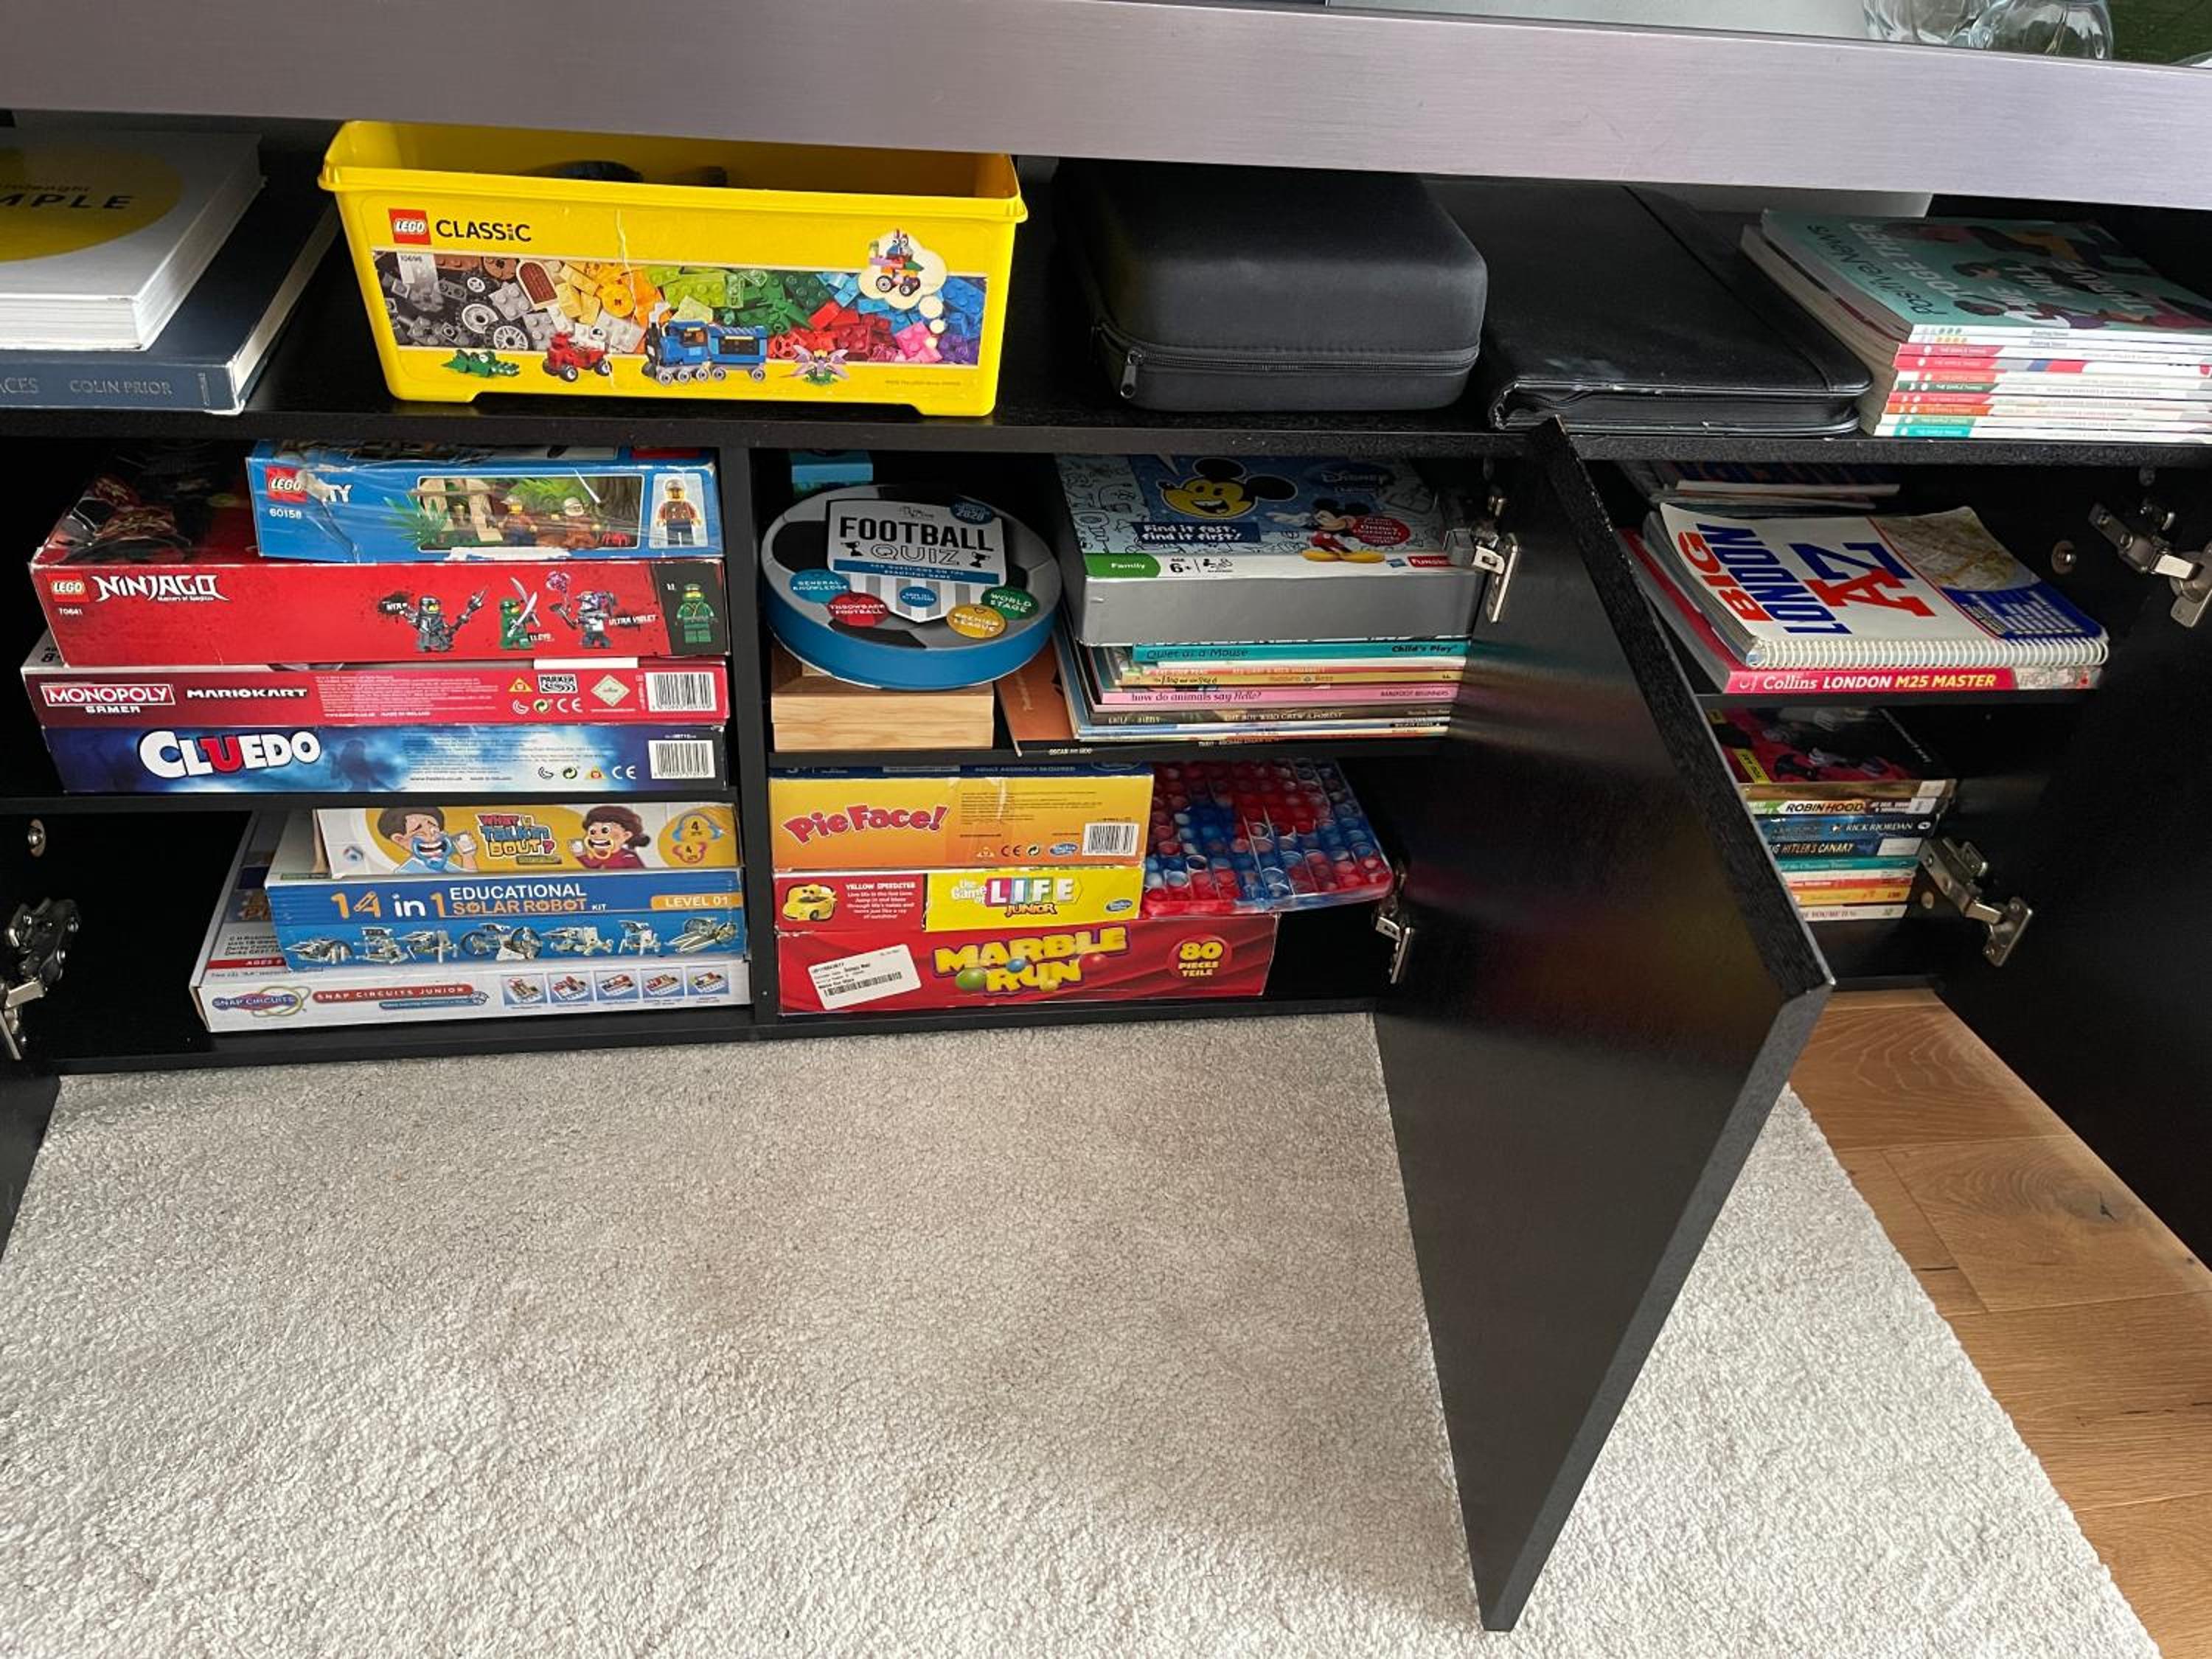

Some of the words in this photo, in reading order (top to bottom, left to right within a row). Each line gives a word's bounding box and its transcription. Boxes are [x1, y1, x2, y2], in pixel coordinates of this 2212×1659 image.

[395, 219, 425, 234] LEGO
[70, 380, 119, 394] COLIN
[123, 380, 173, 395] PRIOR
[840, 517, 994, 552] FOOTBALL
[1144, 524, 1176, 532] Find
[1180, 524, 1193, 532] it
[1142, 532, 1176, 540] find
[1180, 532, 1193, 540] it
[1197, 533, 1242, 541] first!
[871, 543, 959, 566] QUIZ
[1677, 531, 1774, 622] BIG
[1695, 523, 1853, 635] LONDON
[53, 581, 85, 594] LEGO
[91, 575, 231, 602] NINJAGO
[990, 593, 1032, 608] WORLD
[608, 617, 632, 626] ULTRA
[1147, 649, 1180, 660] Quiet
[1209, 648, 1248, 657] Mouse
[1391, 644, 1427, 653] Child's
[1430, 645, 1455, 654] Play
[540, 675, 575, 684] PARKER
[1763, 675, 1818, 690] Collins
[1822, 676, 1891, 689] LONDON
[1895, 675, 1929, 687] M25
[1932, 675, 1997, 687] MASTER
[48, 686, 167, 703] MONOPOLY
[1132, 693, 1154, 702] how
[1155, 693, 1169, 701] do
[1175, 692, 1211, 701] animals
[1214, 694, 1232, 704] say
[86, 706, 141, 714] GAMER
[139, 730, 321, 779] CLUEDO
[1786, 802, 1825, 813] ROBIN
[1826, 801, 1863, 812] HOOD
[691, 821, 698, 831] 4
[783, 812, 849, 844] Pie
[847, 804, 949, 831] Face!
[1846, 823, 1869, 832] RICK
[1870, 822, 1913, 831] RIORDAN
[1781, 843, 1816, 855] HITLER'S
[1818, 843, 1853, 854] CANARY
[450, 883, 587, 901] EDUCATIONAL
[990, 878, 1075, 904] LIFE
[331, 890, 381, 919] 14
[392, 893, 425, 918] in
[430, 892, 445, 919] 1
[453, 901, 520, 916] SOLAR
[524, 897, 587, 914] ROBOT
[592, 903, 607, 911] KIT
[665, 897, 709, 908] LEVEL
[713, 896, 728, 905] 01
[1005, 902, 1057, 917] JUNIOR
[934, 927, 1128, 974] MARBLE
[1180, 941, 1223, 960] 80
[1178, 961, 1219, 970] PIECES
[1182, 968, 1213, 977] TEILE
[986, 959, 1082, 992] RUN
[356, 989, 414, 998] CIRCUITS
[419, 987, 464, 995] JUNIOR
[215, 998, 243, 1007] SNAP
[246, 996, 296, 1006] CIRCUITS
